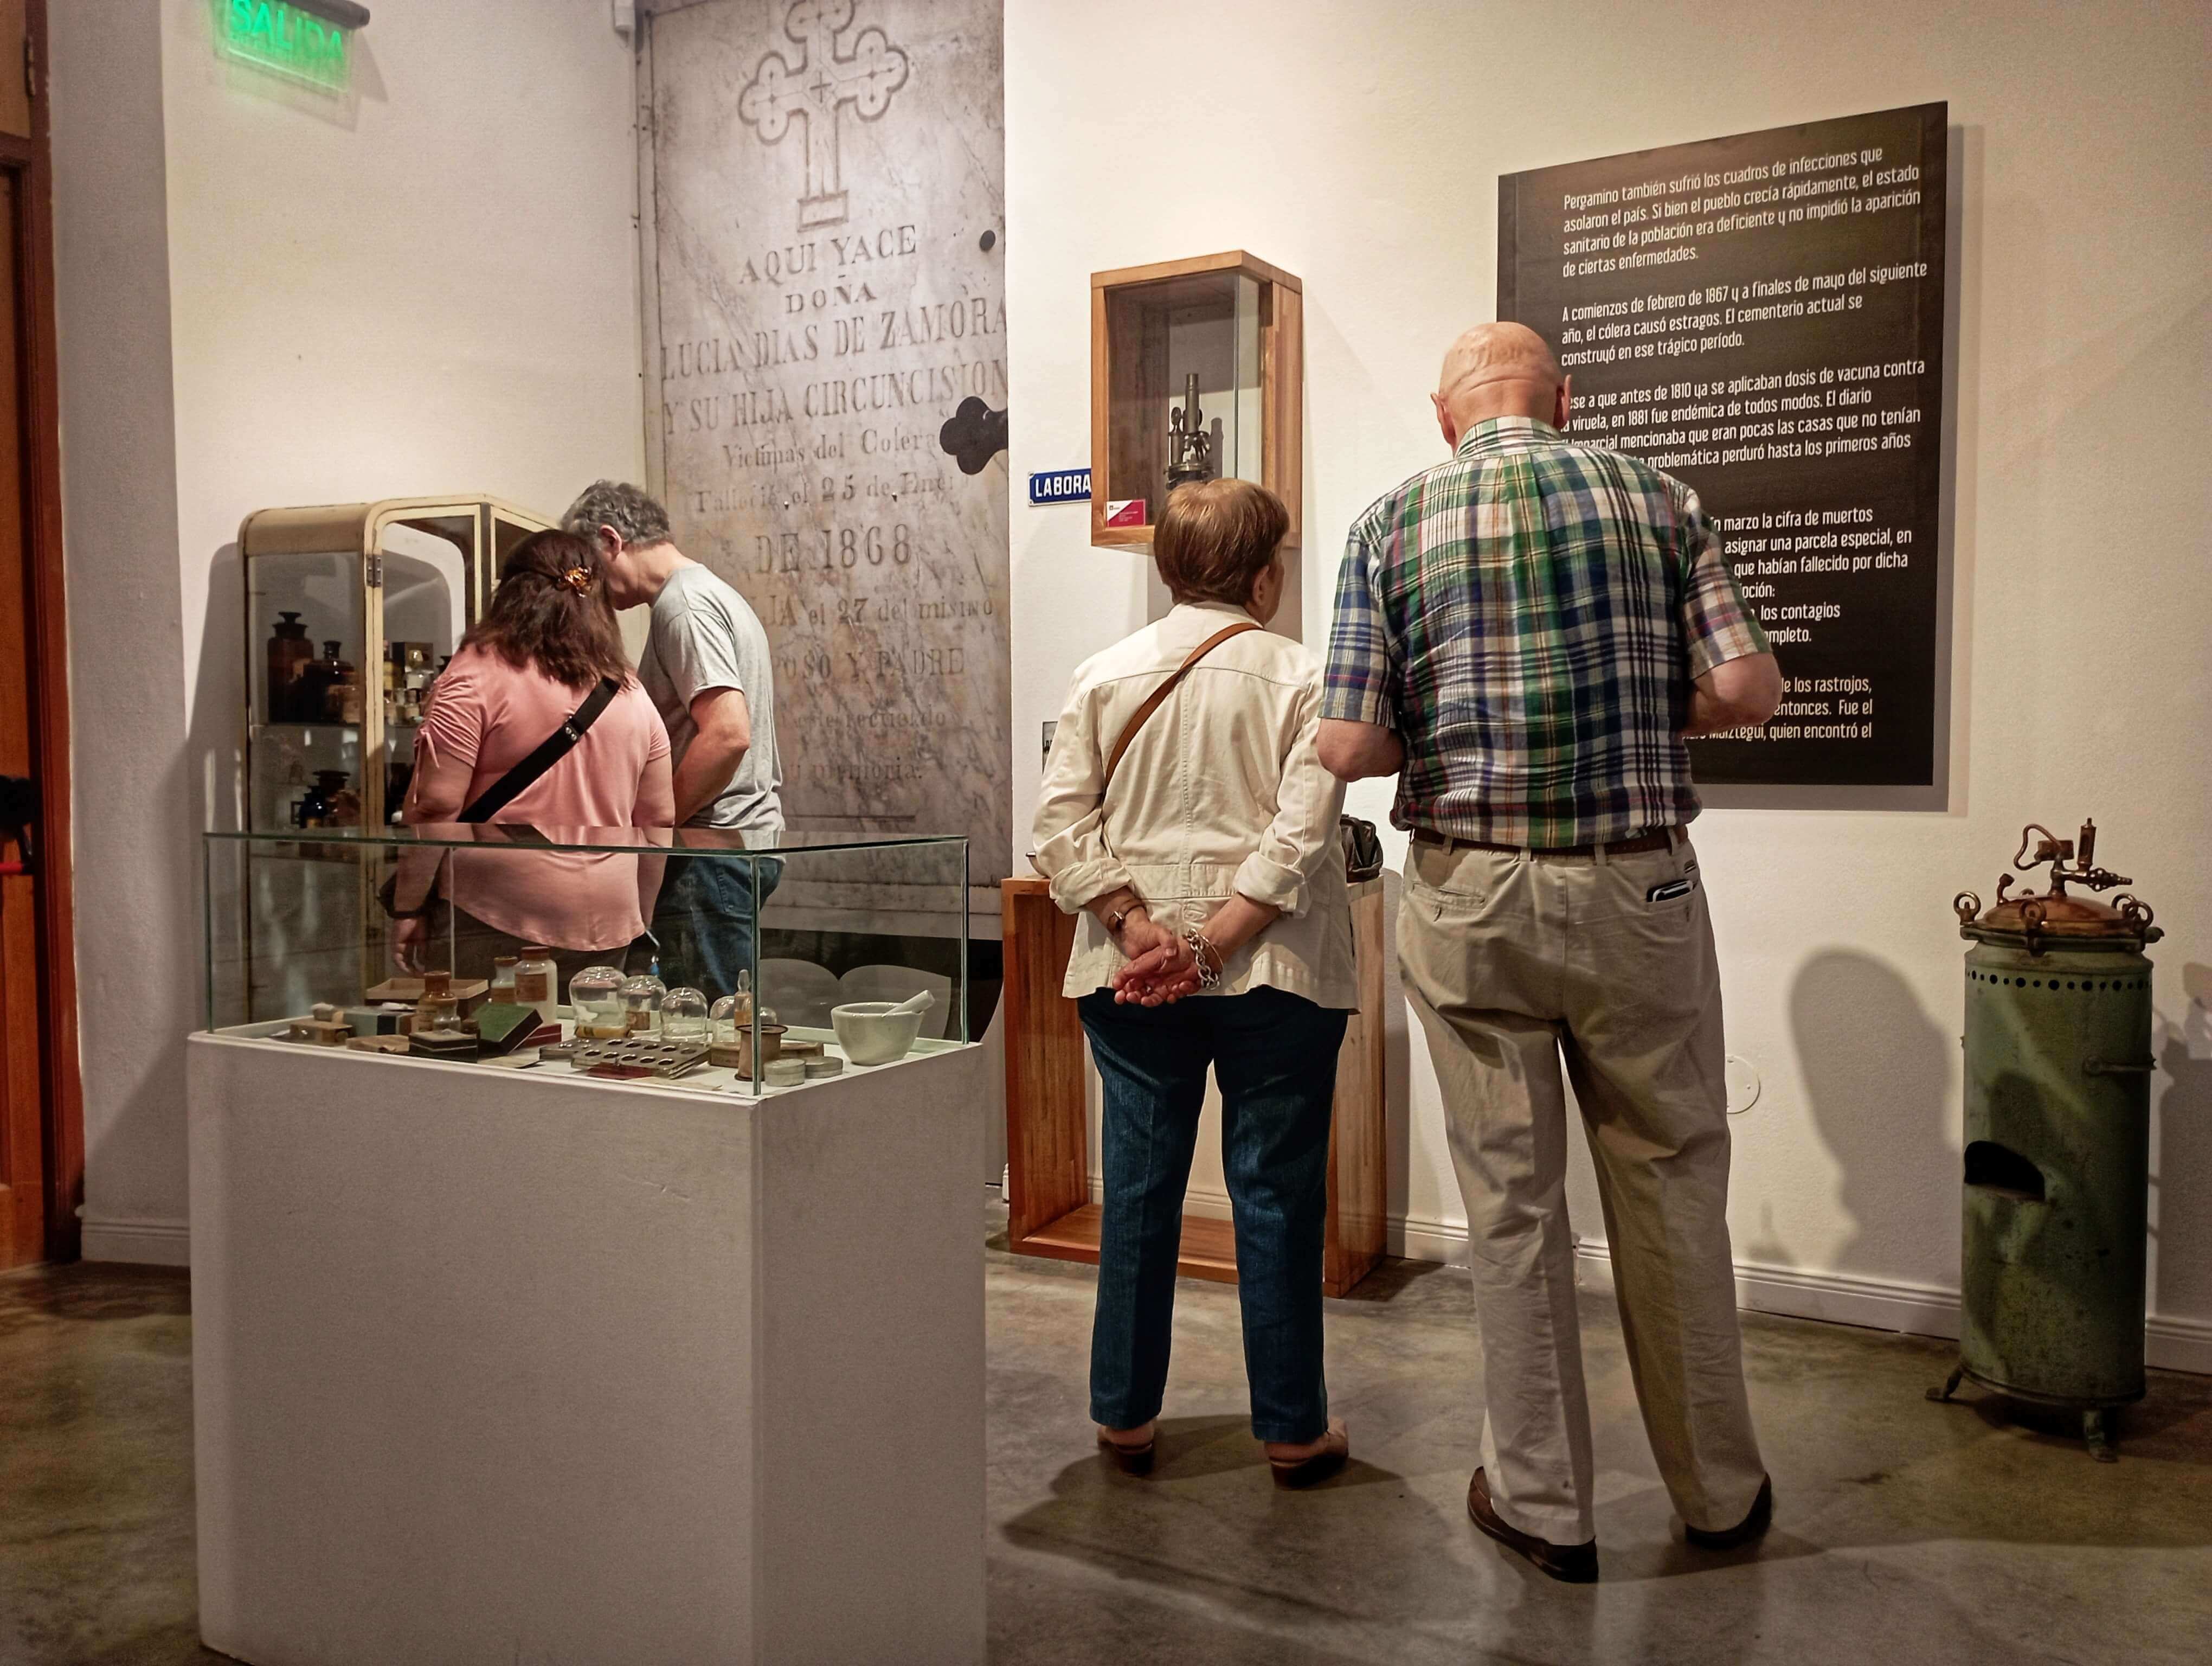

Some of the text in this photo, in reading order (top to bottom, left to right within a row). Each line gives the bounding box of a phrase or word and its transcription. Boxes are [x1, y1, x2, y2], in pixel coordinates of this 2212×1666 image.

[231, 0, 344, 60] SALIDA
[1564, 148, 1883, 211] Pergamino también sufrió los cuadros de infecciones que
[1563, 164, 1920, 233] asolaron el país. Si bien el pueblo crecía rápidamente, el estado
[1563, 188, 1921, 255] sanitario de la población era deficiente y no impidió la aparición
[740, 225, 916, 287] AQUI YACE
[1562, 245, 1699, 278] de ciertas enfermedades.
[786, 274, 877, 314] DOÑA
[1562, 261, 1927, 323] A comienzos de febrero de 1867 y a finales de mayo del siguiente
[1561, 293, 1863, 345] año, el cólera causó estragos. El cementerio actual se
[661, 296, 1007, 380] LUCIA DIAS DE ZAMORA
[1561, 330, 1745, 367] construyó en ese trágico período.
[664, 359, 1008, 434] Y SU HIJA CIRCUNCISION
[1588, 359, 1925, 409] a que antes de 1810 ya se aplicaban dosis de vacuna contra
[1572, 386, 1872, 432] viruela, en 1881 fue endémica de todos modos. El diario
[816, 433, 844, 459] del
[1620, 406, 1921, 450] mencionaba que eran pocas las casas que no tenían
[1647, 450, 1720, 469] problemática
[1722, 443, 1765, 466] perduró
[1767, 442, 1802, 459] hasta
[1804, 439, 1823, 456] los
[1825, 435, 1878, 458] primeros
[1881, 432, 1911, 450] años
[822, 474, 855, 502] 25
[867, 475, 891, 497] de
[1035, 473, 1092, 497] LABORA
[1724, 516, 1759, 532] marzo
[1761, 512, 1773, 529] la
[1775, 510, 1802, 528] cifra
[1804, 509, 1819, 527] de
[1822, 507, 1873, 526] muertos
[755, 524, 911, 573] DE 1868
[1724, 527, 1912, 556] asignar una parcela especial, en
[1733, 550, 1908, 579] que habían fallecido por dicha
[838, 597, 869, 625] 27
[878, 597, 907, 621] del
[1760, 604, 1778, 621] los
[1780, 601, 1841, 621] contagios
[1764, 626, 1812, 646] mpleto.
[876, 647, 964, 678] PADRE
[1794, 675, 1872, 695] los rastrojos,
[1838, 699, 1859, 715] Fue
[1862, 698, 1873, 715] el
[1769, 722, 1801, 742] quien
[1804, 722, 1858, 739] encontró
[1861, 721, 1872, 739] el
